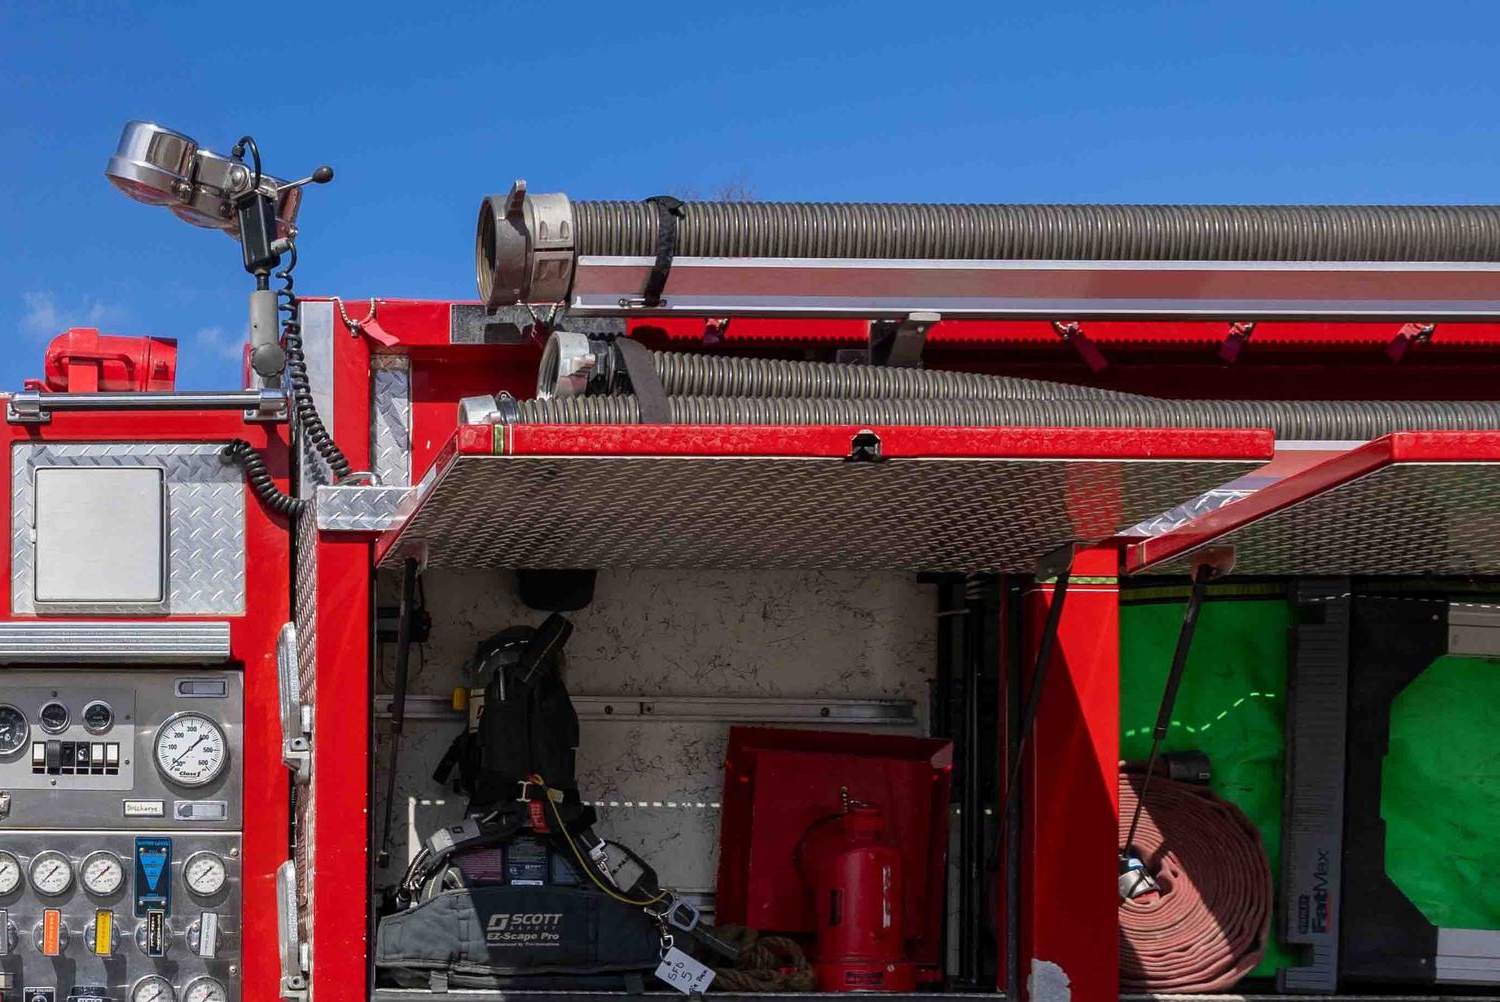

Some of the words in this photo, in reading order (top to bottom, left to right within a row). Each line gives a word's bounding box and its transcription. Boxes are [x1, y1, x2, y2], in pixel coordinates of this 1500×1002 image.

[510, 913, 563, 924] SCOTT
[487, 932, 538, 942] EZ-Scape
[541, 932, 559, 940] Pro
[681, 972, 692, 982] 5
